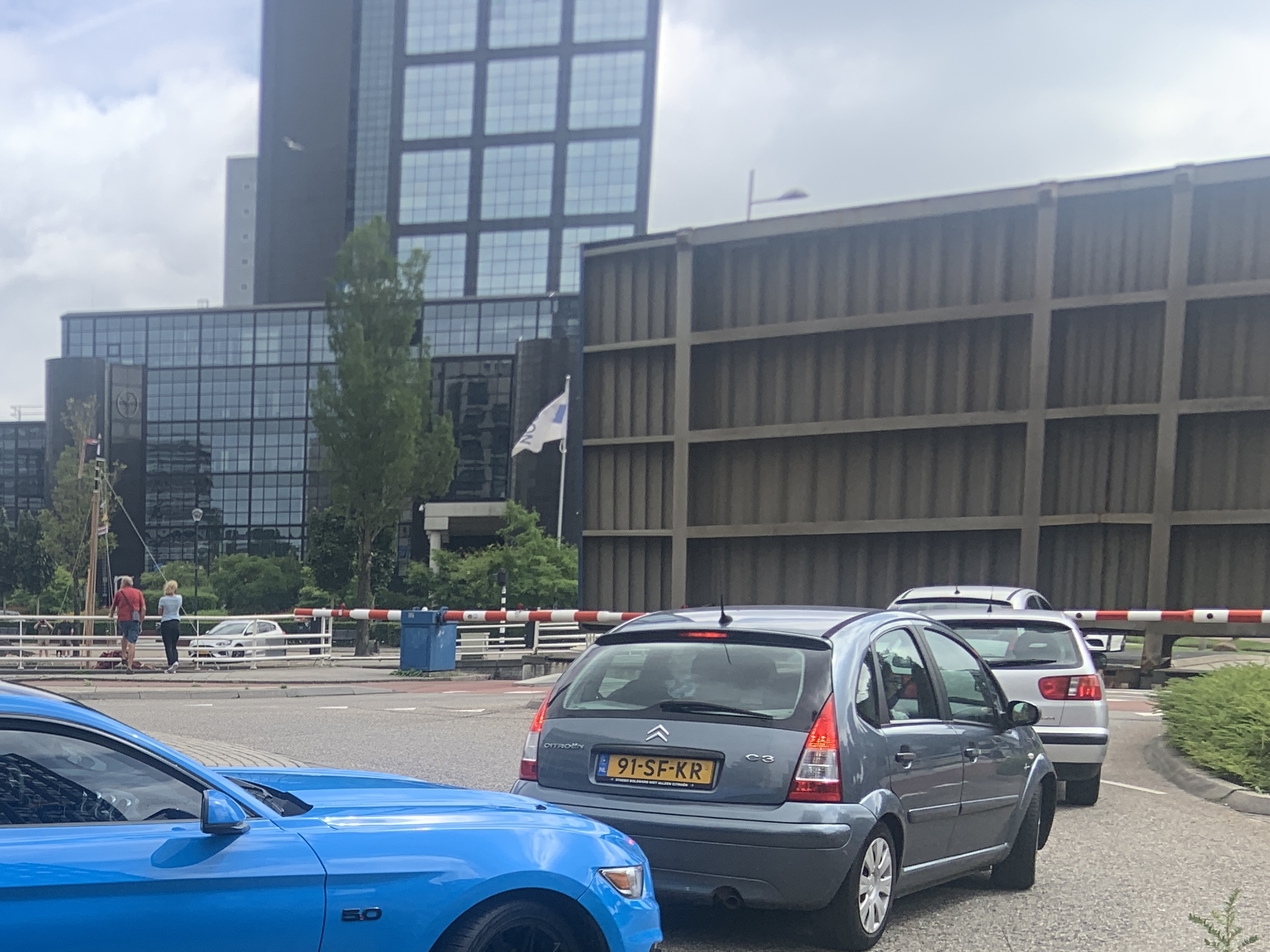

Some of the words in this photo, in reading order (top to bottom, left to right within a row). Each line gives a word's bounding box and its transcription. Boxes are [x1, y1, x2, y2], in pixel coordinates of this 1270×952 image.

[745, 753, 775, 763] C3
[618, 758, 702, 780] 91-SF-KR
[341, 907, 382, 920] 5.0
